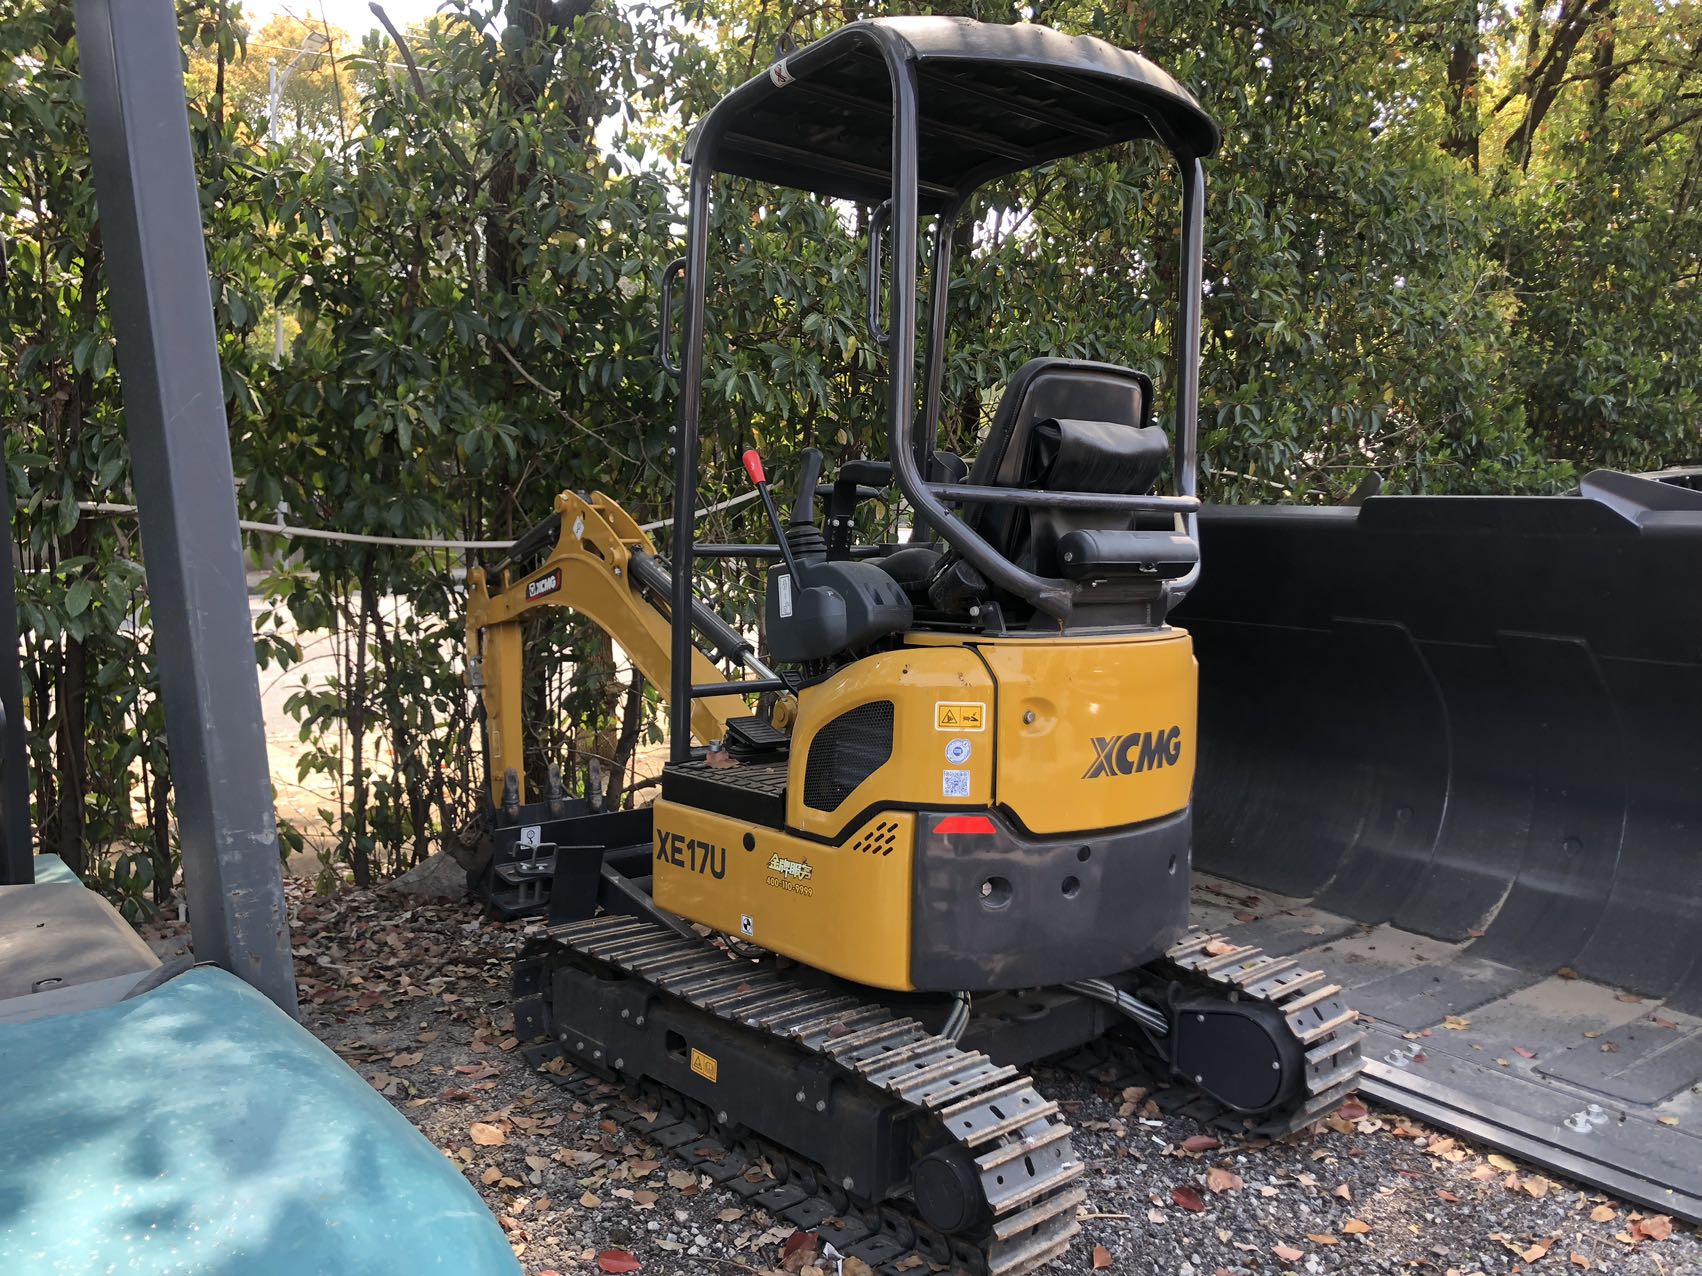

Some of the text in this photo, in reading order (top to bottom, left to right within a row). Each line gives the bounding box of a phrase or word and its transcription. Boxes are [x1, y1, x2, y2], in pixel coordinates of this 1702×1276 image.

[1080, 725, 1181, 779] XCMG
[656, 828, 726, 880] XE17U
[766, 876, 813, 897] 400-110-9999
